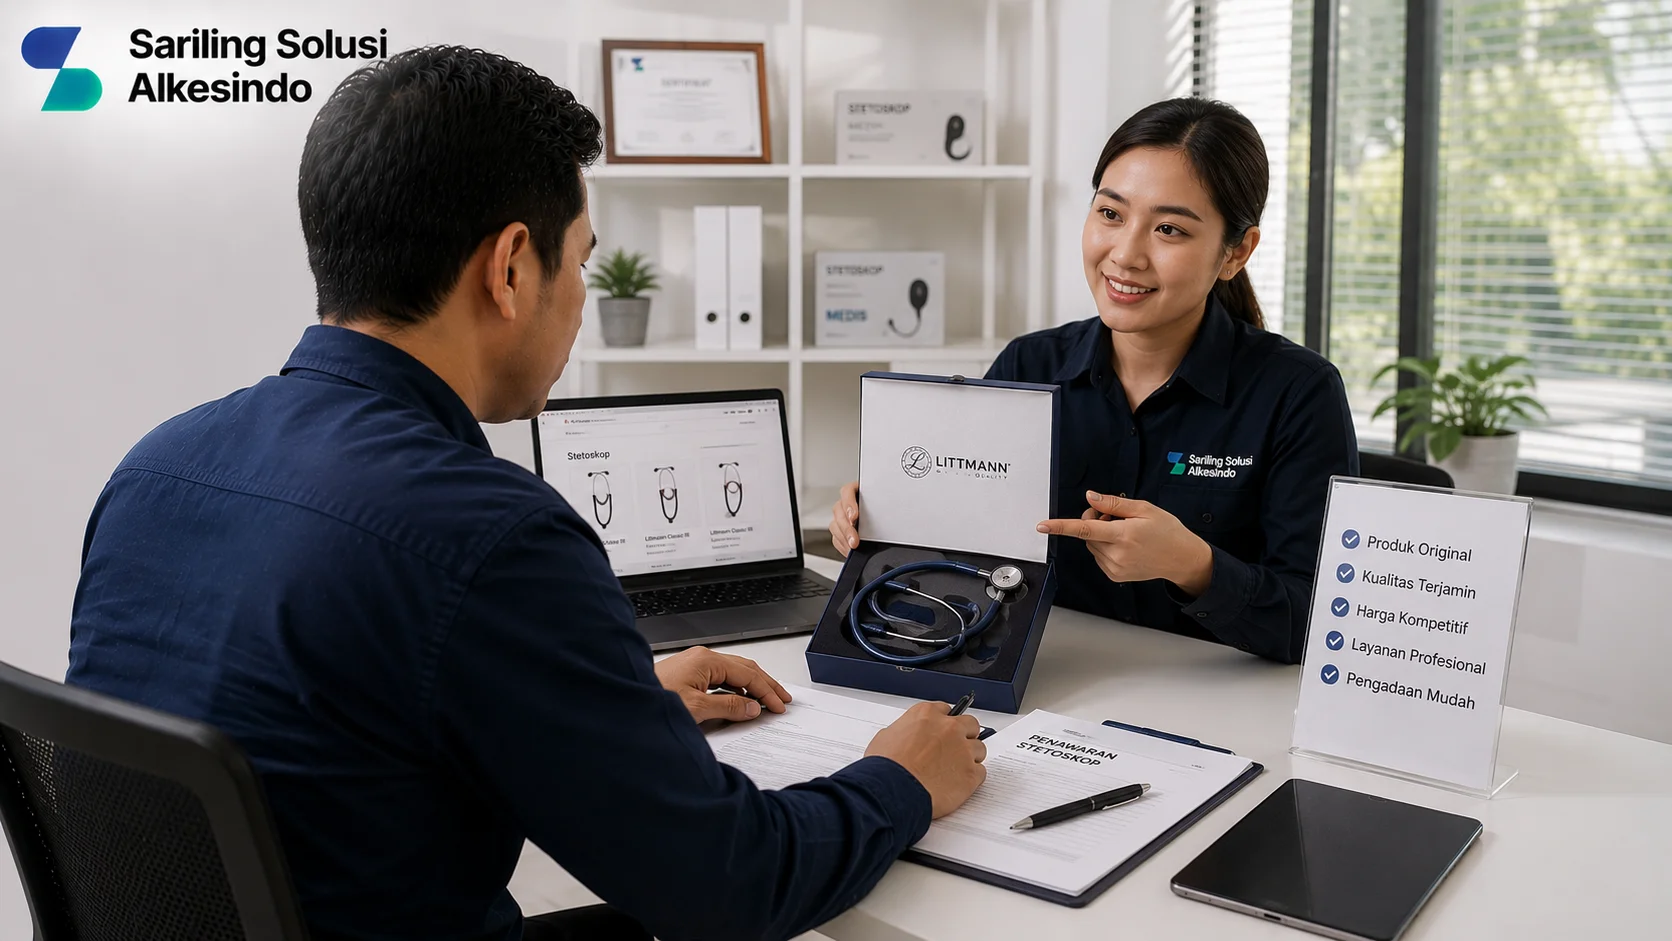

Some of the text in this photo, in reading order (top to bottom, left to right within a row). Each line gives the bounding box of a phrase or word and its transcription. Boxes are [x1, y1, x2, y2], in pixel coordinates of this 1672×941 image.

[567, 450, 610, 461] Stetoskop
[936, 456, 1008, 473] LITTMANN
[1188, 454, 1253, 468] Sariling Solusi
[1187, 466, 1237, 478] Alkesindo
[1367, 535, 1472, 562] Produk Original
[1362, 570, 1476, 600] Kualitas Terjamin
[1356, 604, 1469, 635] Harga Kompetitif
[1351, 638, 1486, 675] Layanan Profesional
[1346, 672, 1476, 710] Pengadaan Mudah
[1016, 741, 1101, 767] STETOSKOP
[1028, 734, 1118, 760] PENAWARAN
